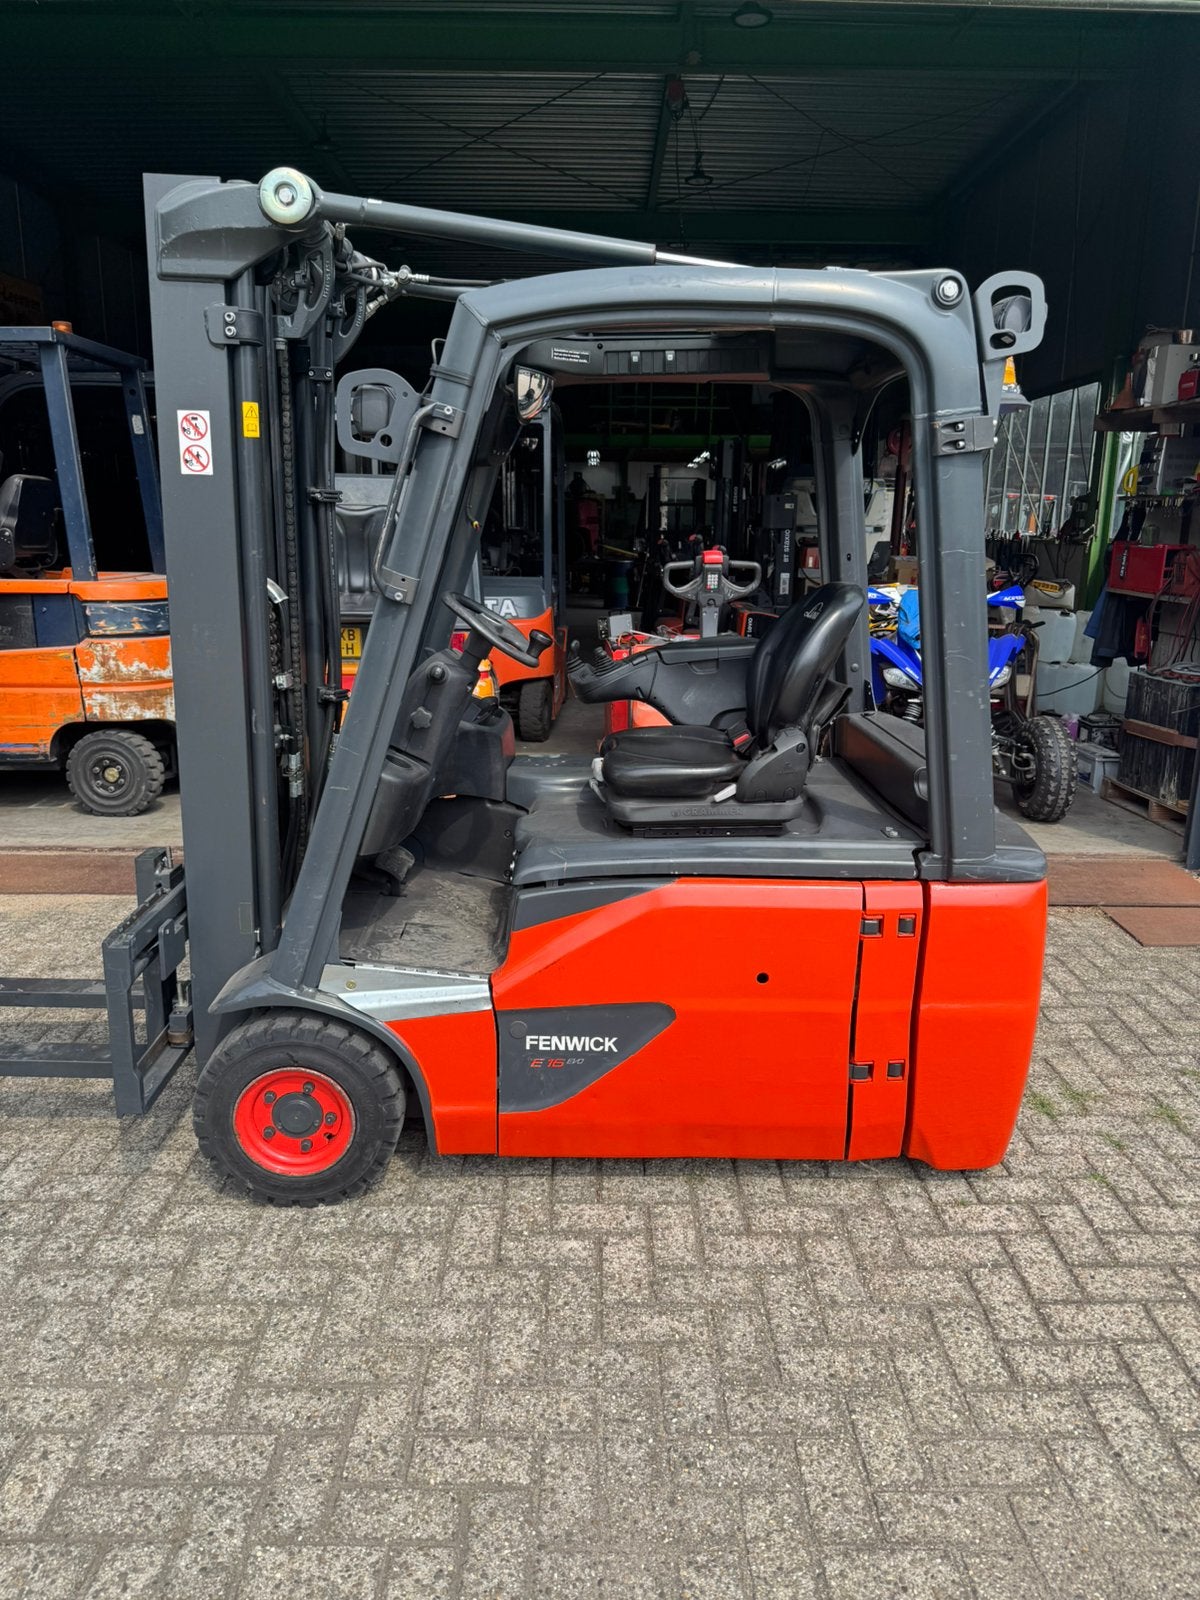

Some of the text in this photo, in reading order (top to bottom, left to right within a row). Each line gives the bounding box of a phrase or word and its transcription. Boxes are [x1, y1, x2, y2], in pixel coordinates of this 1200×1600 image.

[525, 1035, 618, 1052] FENWICK
[530, 1058, 545, 1068] E
[547, 1058, 566, 1068] 16
